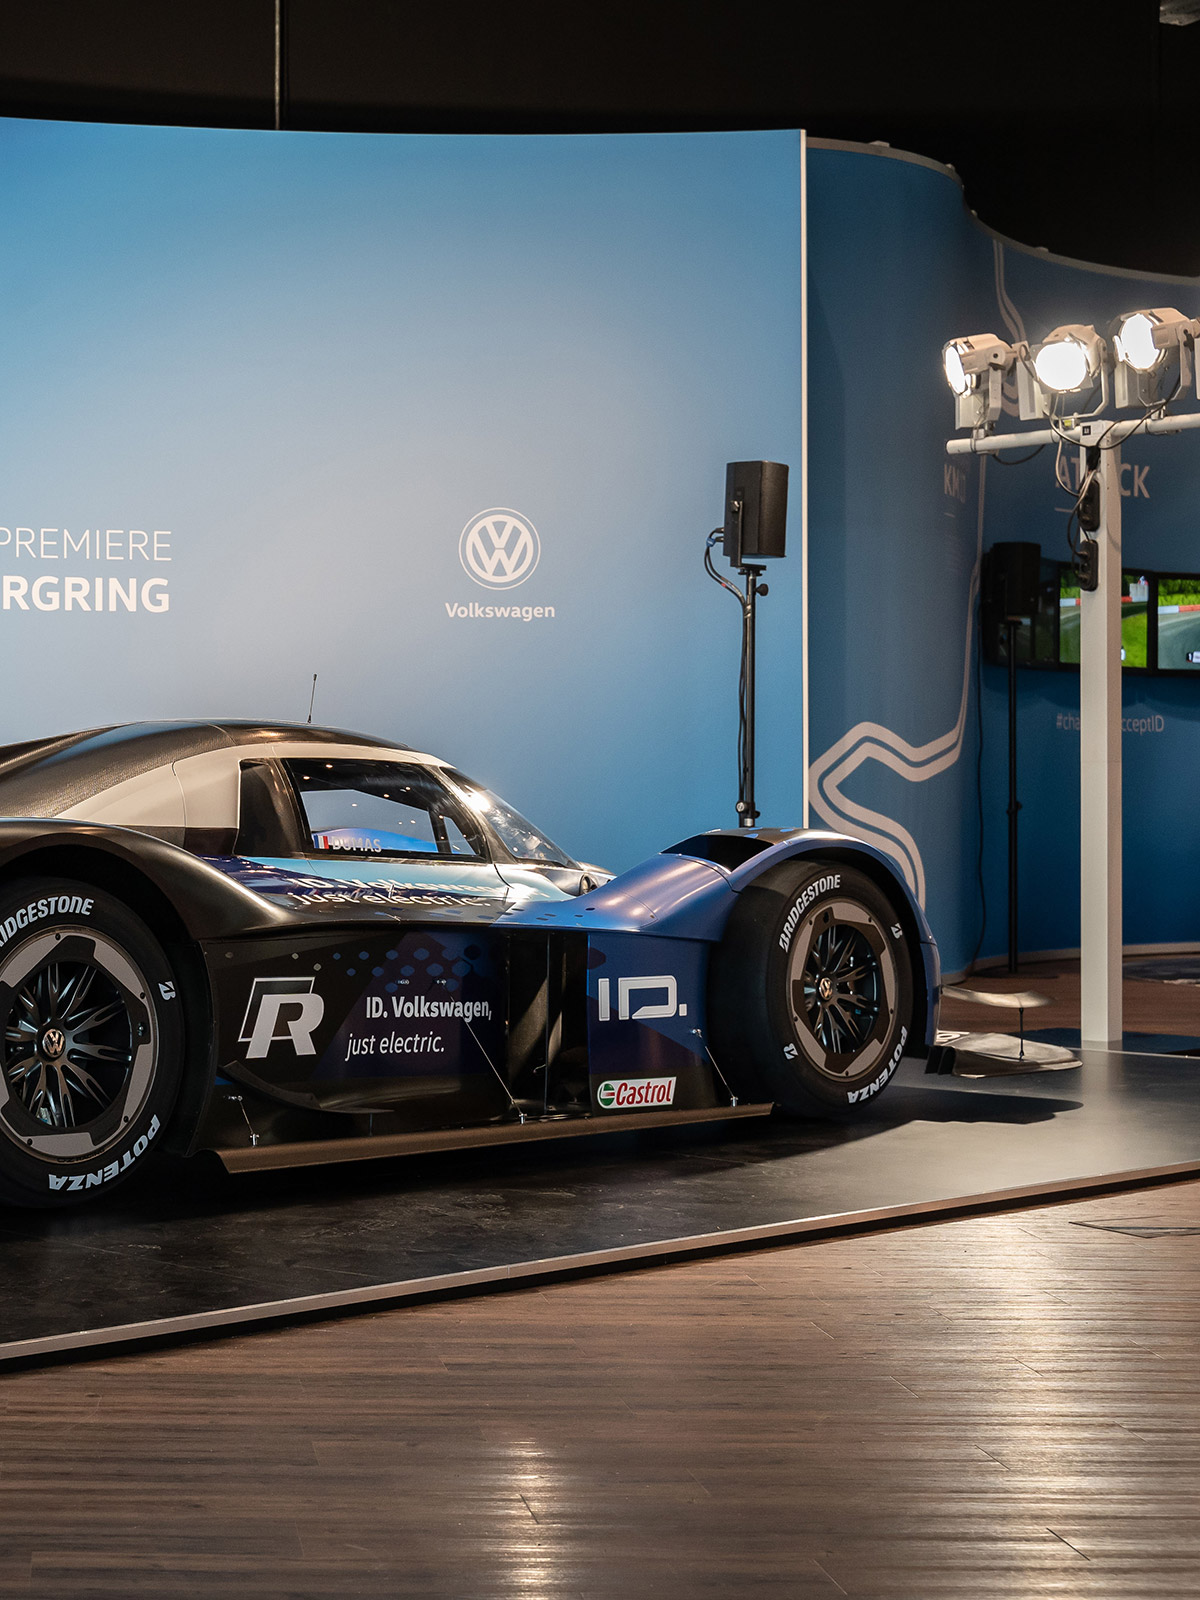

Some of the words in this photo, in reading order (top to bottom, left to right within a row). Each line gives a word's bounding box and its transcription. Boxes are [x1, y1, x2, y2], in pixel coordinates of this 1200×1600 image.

[1055, 455, 1151, 499] ATCK
[444, 602, 556, 622] Volkswagen
[331, 836, 382, 853] DUMAS
[778, 874, 841, 953] BRIDGESTONE
[237, 976, 325, 1059] R
[366, 996, 388, 1019] ID.
[391, 995, 492, 1023] Volkswagen,
[344, 1033, 376, 1062] just
[379, 1030, 445, 1054] electric.
[847, 1025, 908, 1104] POTENZA
[616, 1080, 672, 1106] Castrol
[48, 1114, 161, 1192] POTENZA
